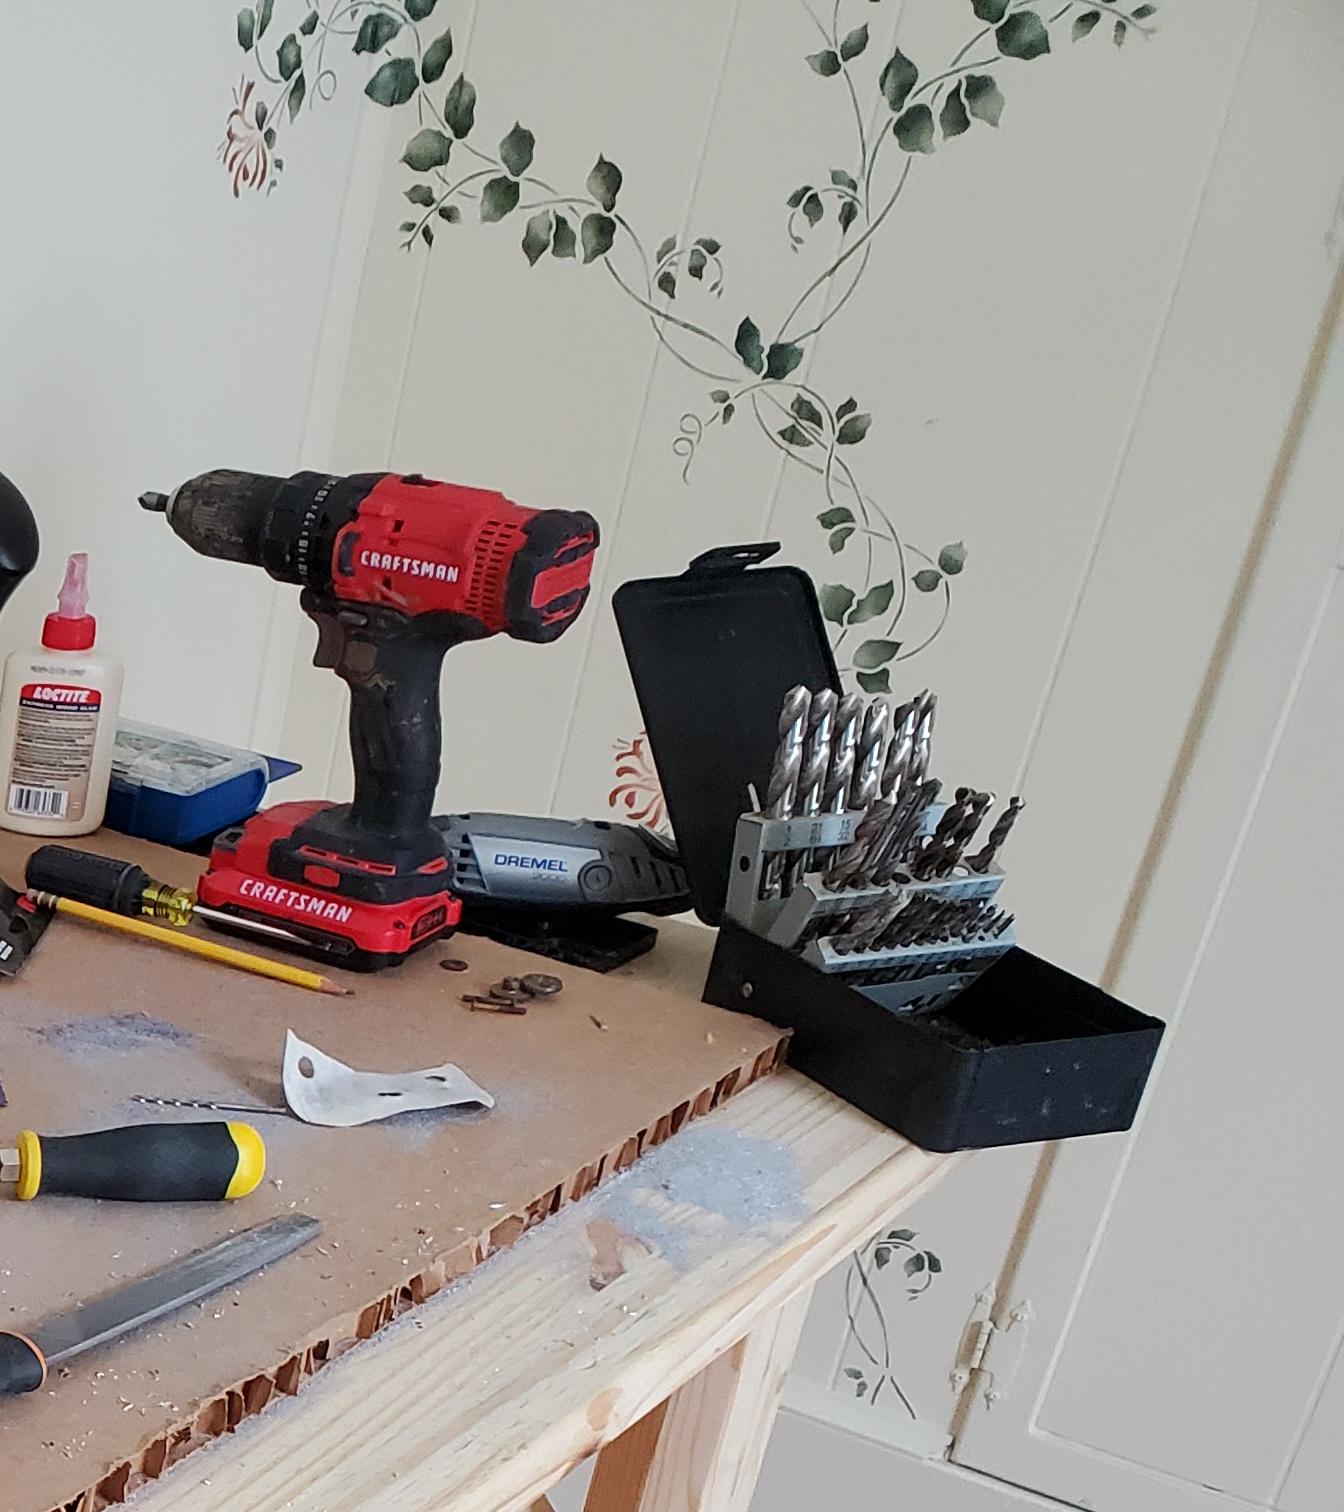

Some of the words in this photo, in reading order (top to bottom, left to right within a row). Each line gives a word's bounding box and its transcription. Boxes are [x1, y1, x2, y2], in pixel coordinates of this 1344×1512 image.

[360, 550, 459, 583] CRAFTSMAN
[33, 687, 91, 702] LOCTITE
[493, 853, 569, 873] DREMEL
[239, 878, 352, 923] CRAFTSMAN
